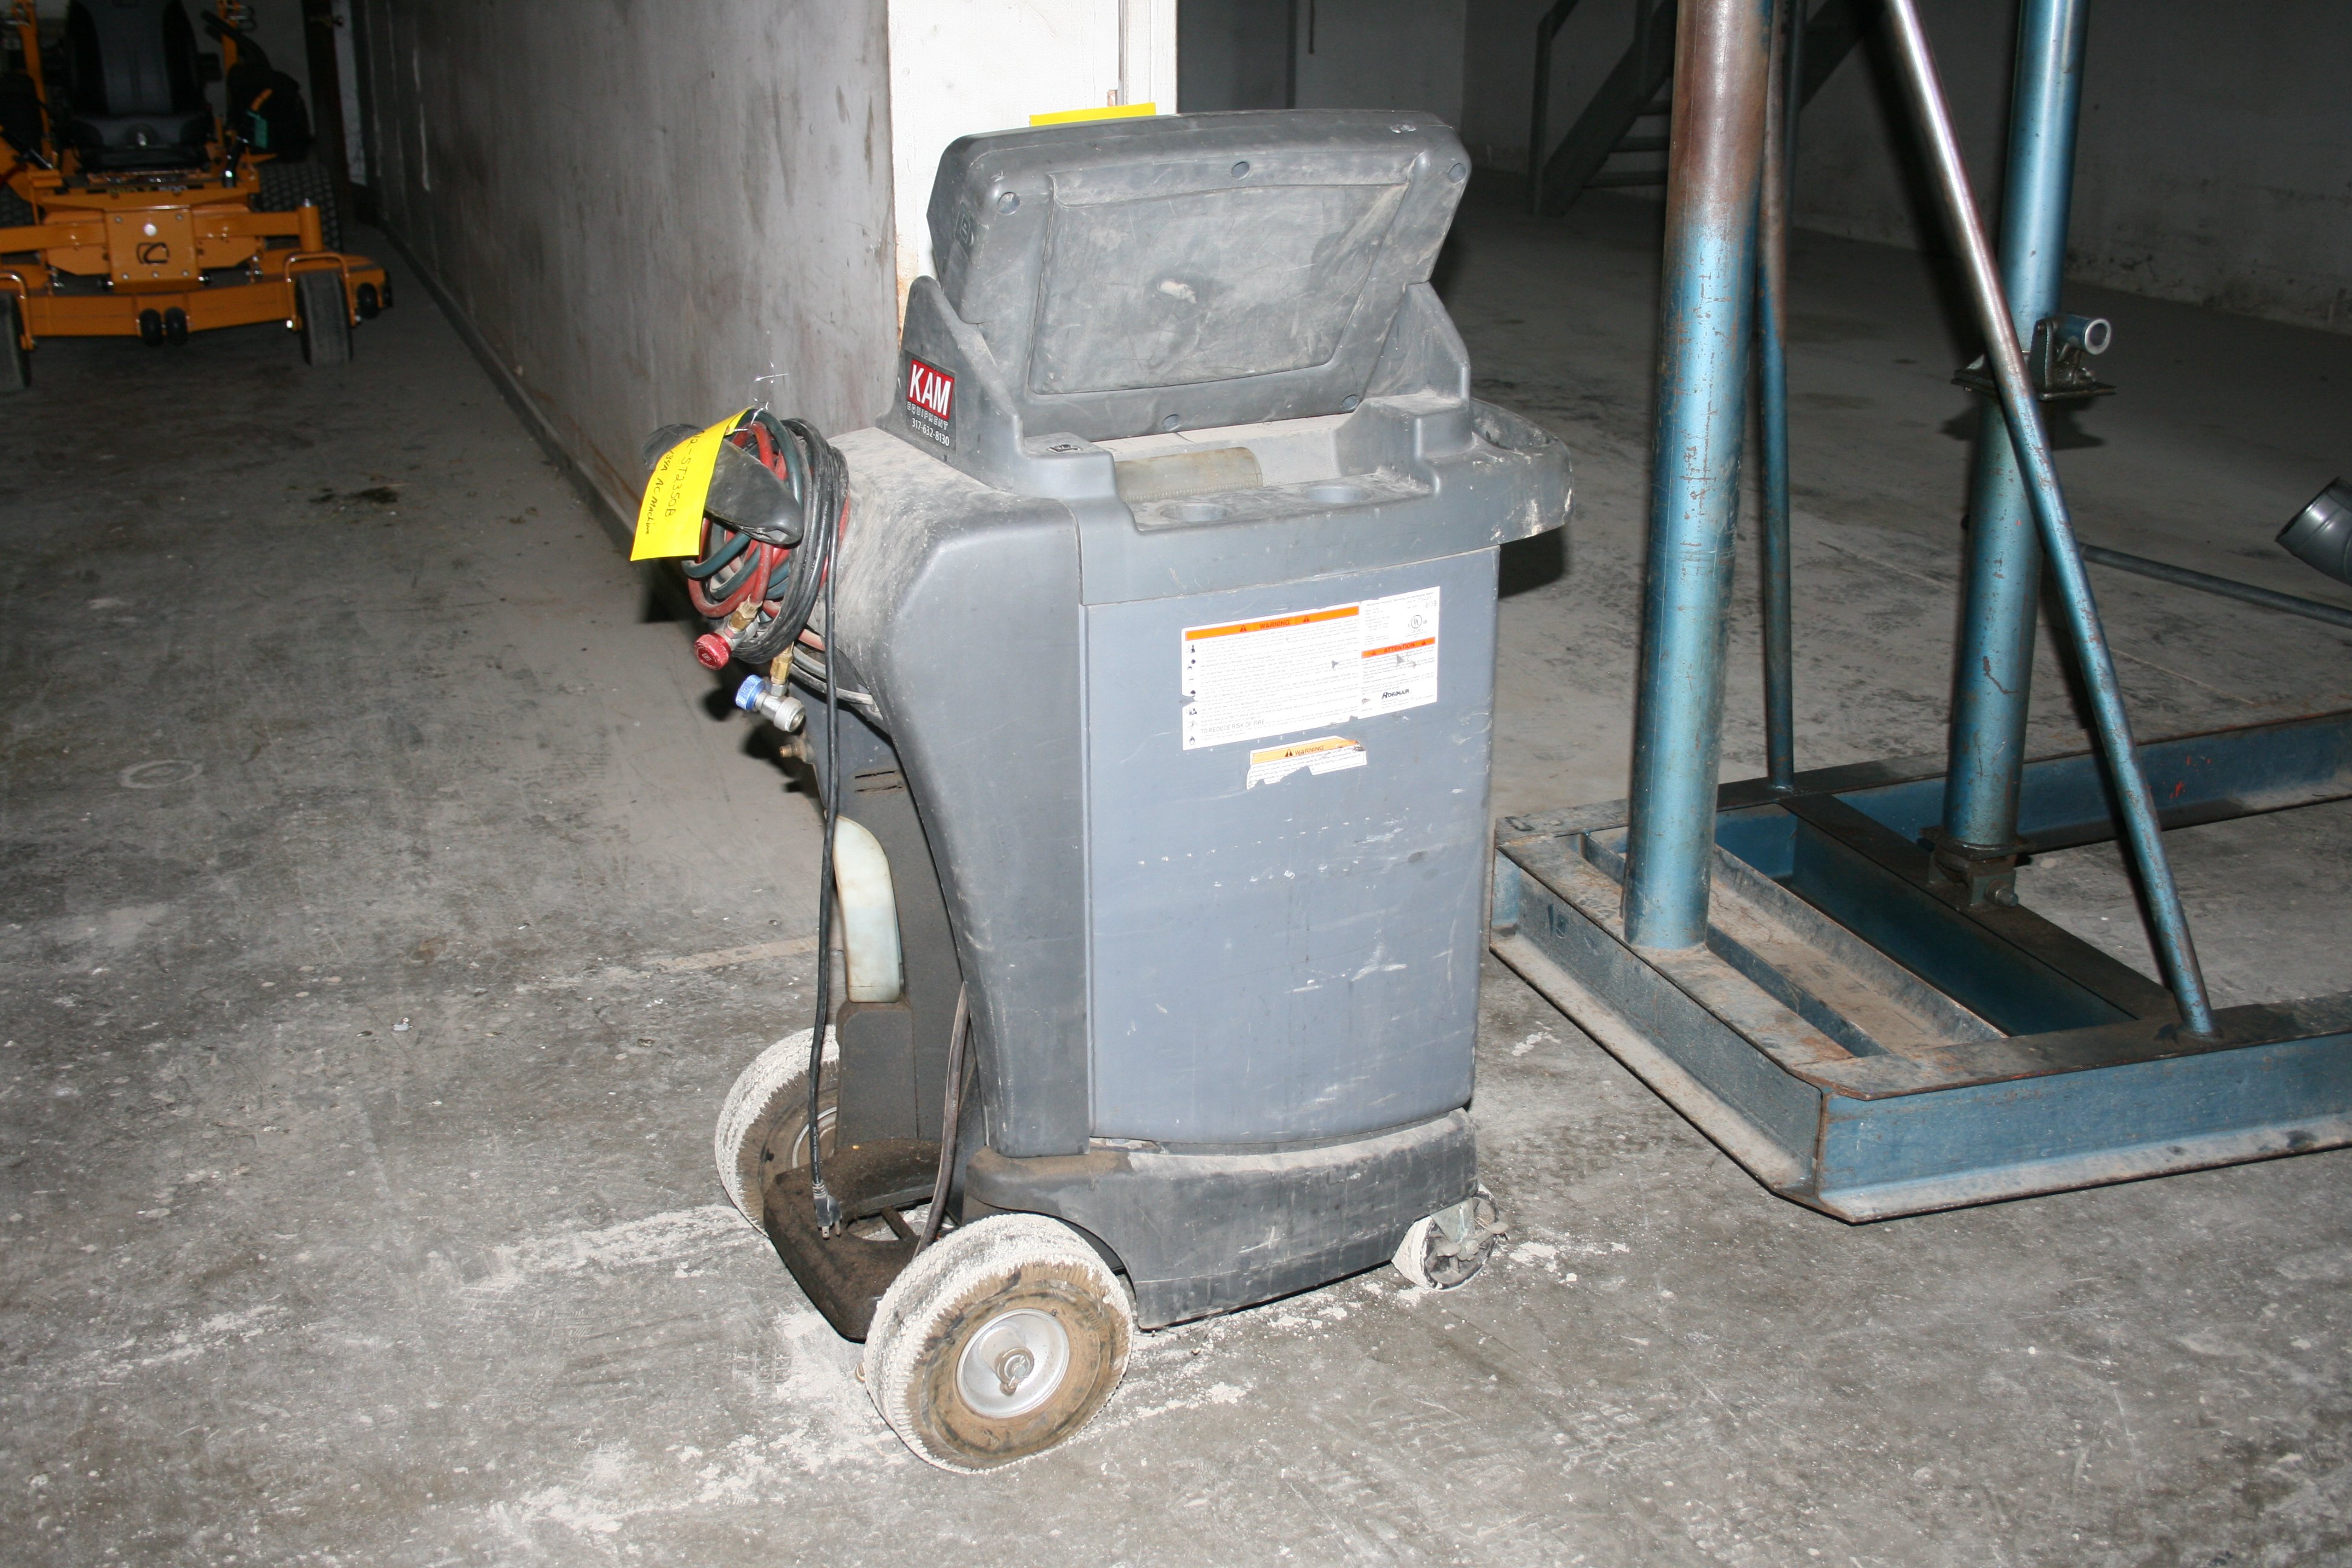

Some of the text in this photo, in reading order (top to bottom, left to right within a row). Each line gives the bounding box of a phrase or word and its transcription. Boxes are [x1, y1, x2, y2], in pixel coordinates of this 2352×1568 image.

[909, 364, 952, 416] KAM
[907, 401, 949, 430] EQUIPMENT
[912, 417, 950, 446] 317-632-8130
[1259, 619, 1290, 629] WARNING
[1383, 642, 1415, 653] ATTENTION
[1295, 745, 1324, 756] WARNING
